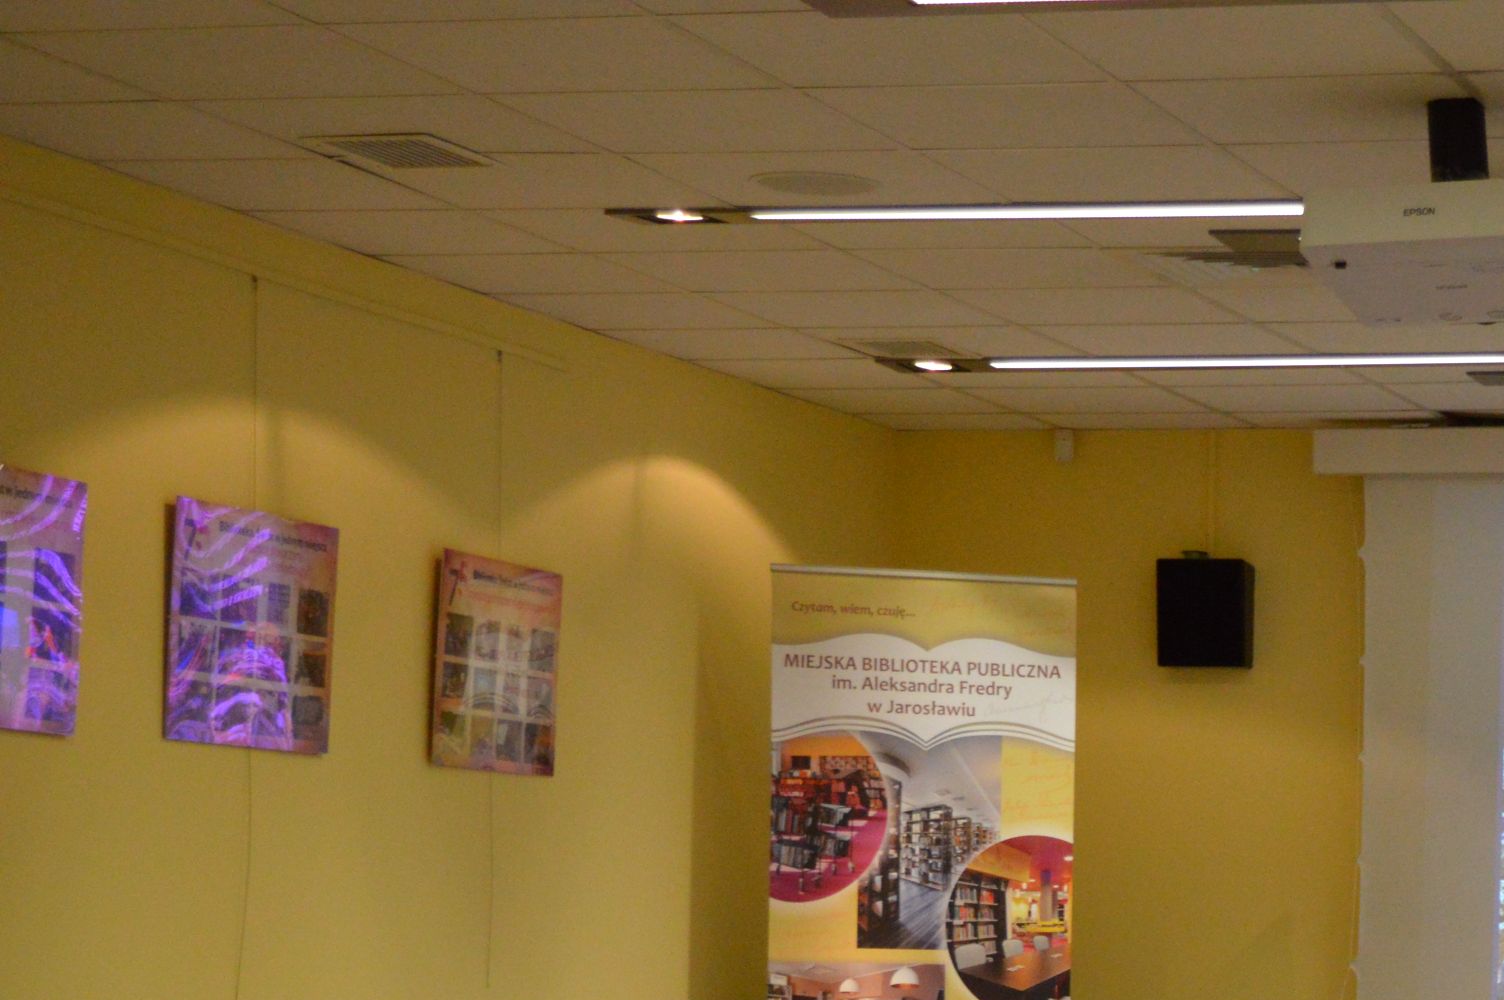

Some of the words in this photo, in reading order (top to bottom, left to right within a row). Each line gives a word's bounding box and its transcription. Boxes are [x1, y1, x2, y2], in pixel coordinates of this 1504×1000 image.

[1403, 207, 1436, 217] EPSON
[791, 601, 838, 615] Czytam,
[840, 604, 874, 617] wiem,
[783, 653, 857, 671] MIEJSKA
[862, 657, 962, 675] BIBLIOTEKA
[967, 662, 1062, 679] PUBLICZNA
[832, 675, 857, 690] im.
[861, 677, 954, 694] Aleksandra
[959, 681, 1012, 700] Fredry
[867, 702, 882, 714] w
[886, 700, 976, 717] Jarosławiu
